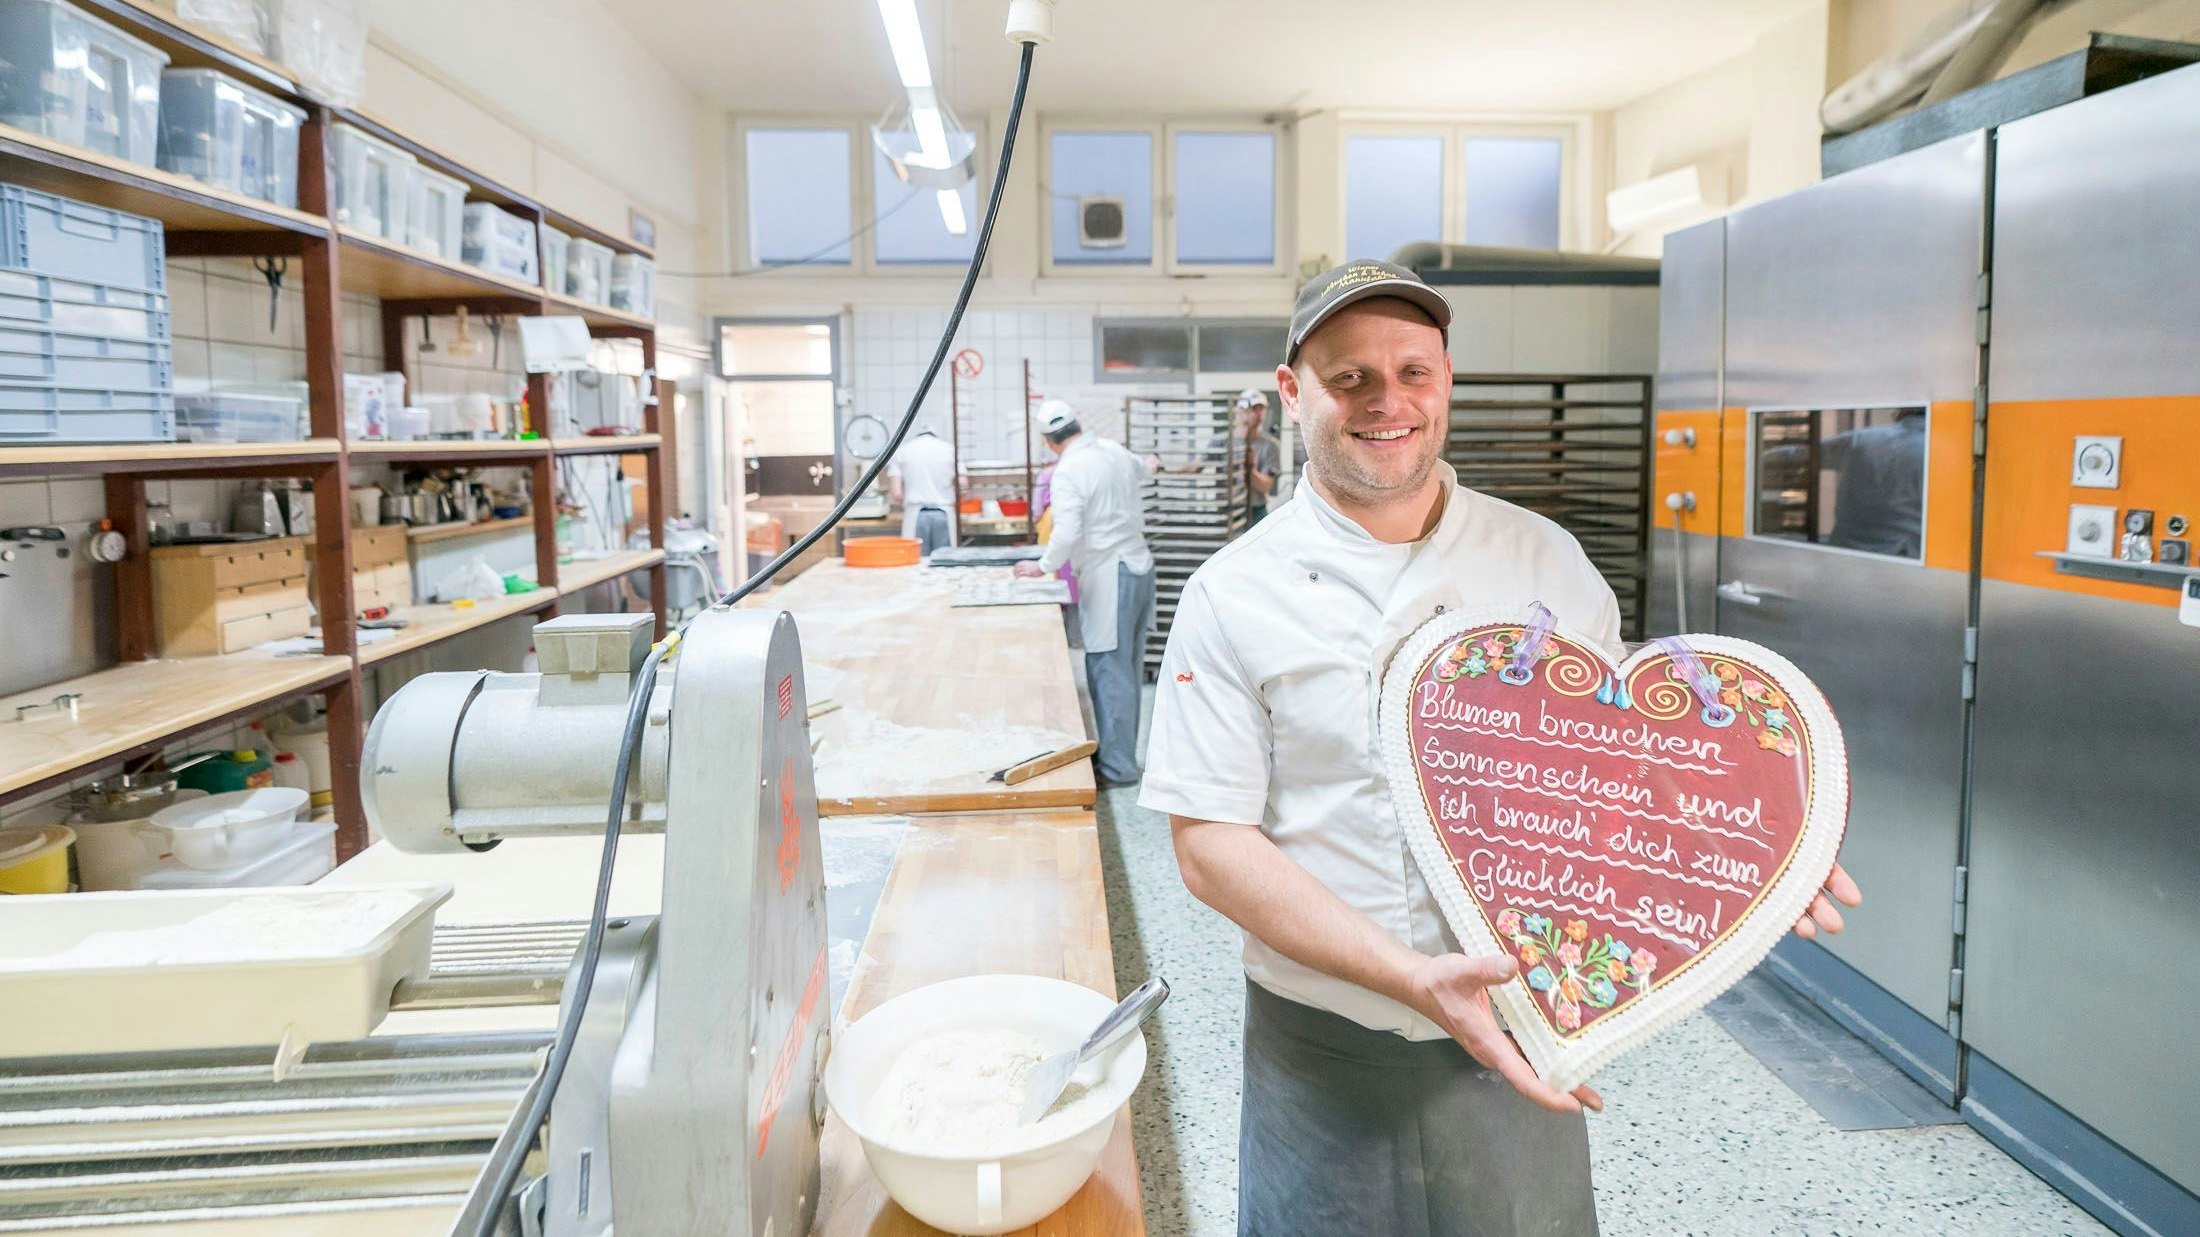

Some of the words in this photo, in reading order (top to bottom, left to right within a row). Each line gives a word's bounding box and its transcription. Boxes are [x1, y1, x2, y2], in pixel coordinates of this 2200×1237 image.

[1416, 680, 1523, 735] Blumen
[1538, 699, 1738, 766] brauchen
[1421, 735, 1654, 807] Sonnenschein
[1676, 792, 1776, 835] und
[1438, 789, 1479, 825] ich
[1609, 824, 1682, 868] dich
[1690, 851, 1763, 888] zum
[1468, 848, 1624, 912] Glücklich
[1634, 896, 1721, 941] sein!
